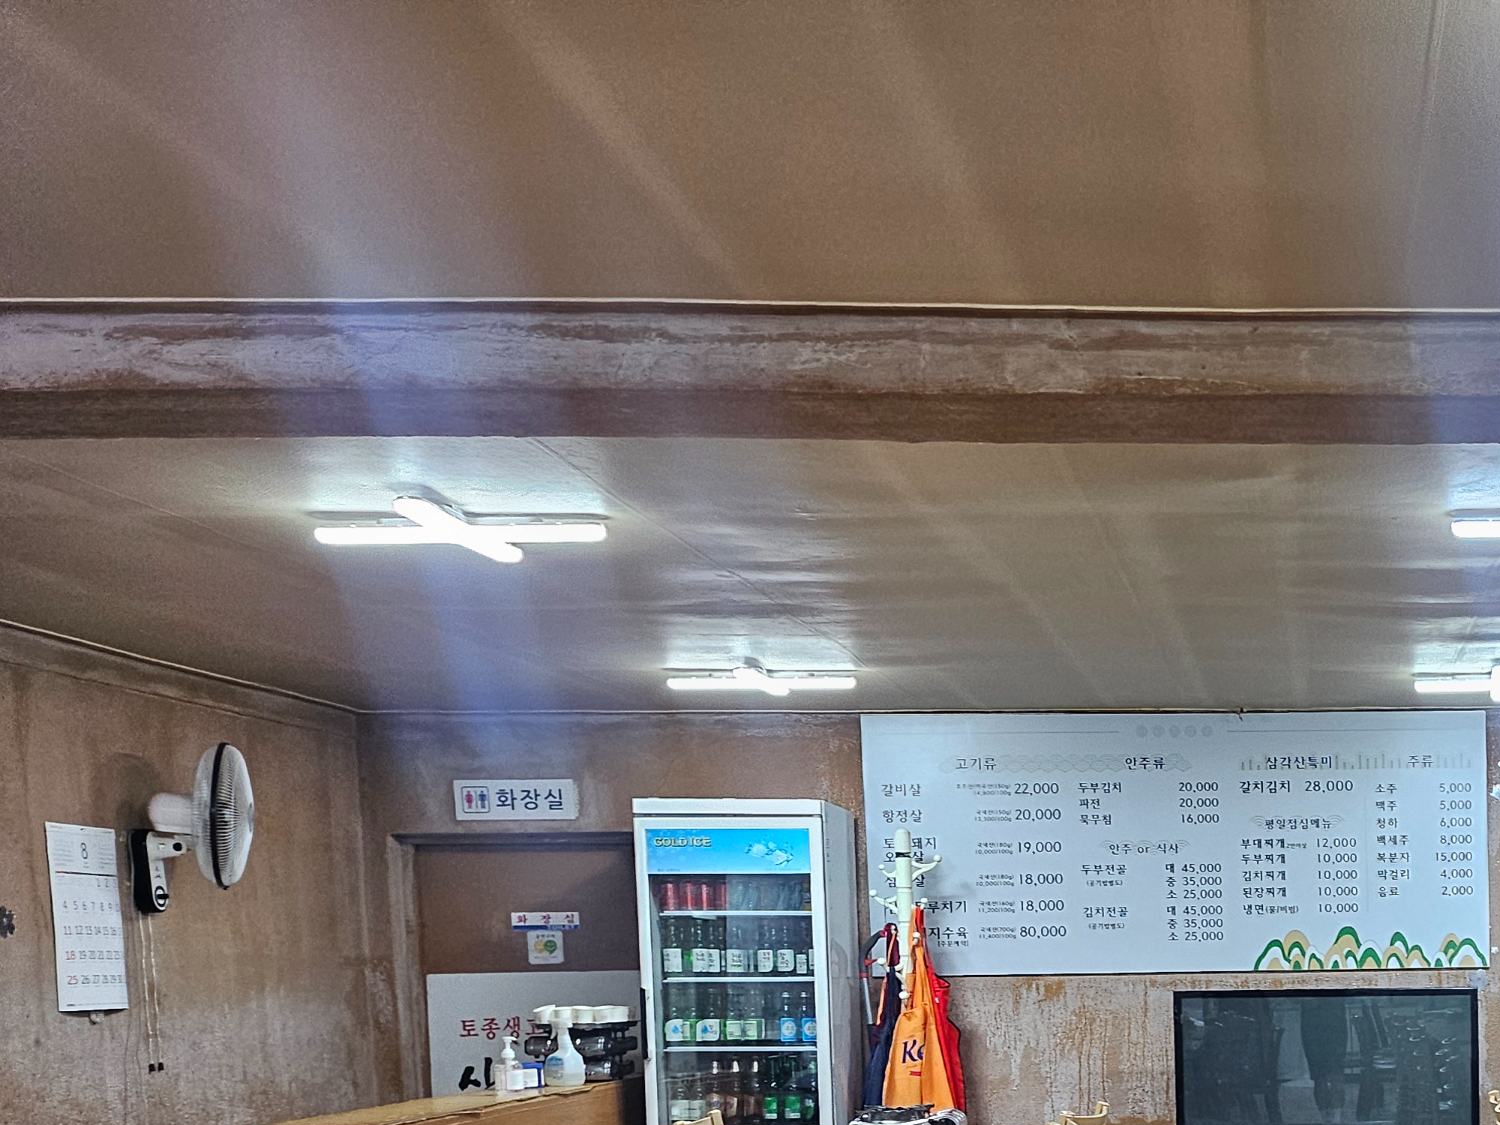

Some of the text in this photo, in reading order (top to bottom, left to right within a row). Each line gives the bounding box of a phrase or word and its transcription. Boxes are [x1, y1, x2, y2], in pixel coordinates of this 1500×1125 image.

[955, 757, 997, 771] 고기류
[1125, 757, 1166, 770] 안주류
[1266, 755, 1332, 770] 삼각산특미
[1407, 755, 1434, 768] 주류
[881, 782, 1060, 797] 갈비살 22,000
[1078, 782, 1219, 793] 두부김치 20,000
[1239, 780, 1354, 794] 갈치김치 28,000
[1375, 783, 1472, 794] 소주 5,000
[495, 788, 564, 810] 화장실
[1079, 798, 1219, 809] 파전 20,000
[1376, 800, 1472, 811] 맥주 5,000
[882, 808, 1061, 823] 항정살 20,000
[1079, 814, 1220, 825] 묵무침 16,000
[1265, 818, 1332, 830] 평일점심메뉴
[1376, 817, 1472, 829] 청하 6,000
[654, 837, 711, 848] GOLD ICE
[883, 837, 937, 850] 토돼지
[1240, 838, 1285, 849] 부대찌개
[1316, 838, 1357, 848] 12,000
[1376, 834, 1473, 845] 백세주 8,000
[81, 842, 88, 860] 8
[884, 841, 1062, 863] 오살 19,000
[1109, 843, 1179, 855] 안주 or 식사
[1241, 853, 1358, 864] 두부찌개 10,000
[1376, 851, 1473, 863] 복분자 15,000
[1081, 864, 1127, 875] 두부전골
[1165, 863, 1222, 874] 대 45,000
[1378, 868, 1473, 880] 막걸리 4,000
[1018, 873, 1063, 886] 18,000
[1242, 870, 1358, 881] 김치찌개 10,000
[1166, 876, 1222, 887] 중 35,000
[1166, 889, 1223, 900] 소 25,000
[1242, 886, 1358, 898] 된장찌개 10,000
[1378, 886, 1474, 897] 음료 2,000
[1019, 899, 1065, 913] 18,000
[1166, 905, 1223, 916] 대 45,000
[1318, 903, 1359, 914] 10,000
[1083, 906, 1128, 918] 김치전골
[63, 925, 72, 935] 11
[75, 925, 84, 935] 12
[1167, 919, 1223, 930] 중 35,000
[924, 925, 1067, 940] 지수육 80,000
[1168, 931, 1224, 942] 소 25,000
[66, 950, 76, 960] 18
[79, 950, 87, 960] 19
[67, 975, 78, 985] 25
[80, 975, 90, 984] 26
